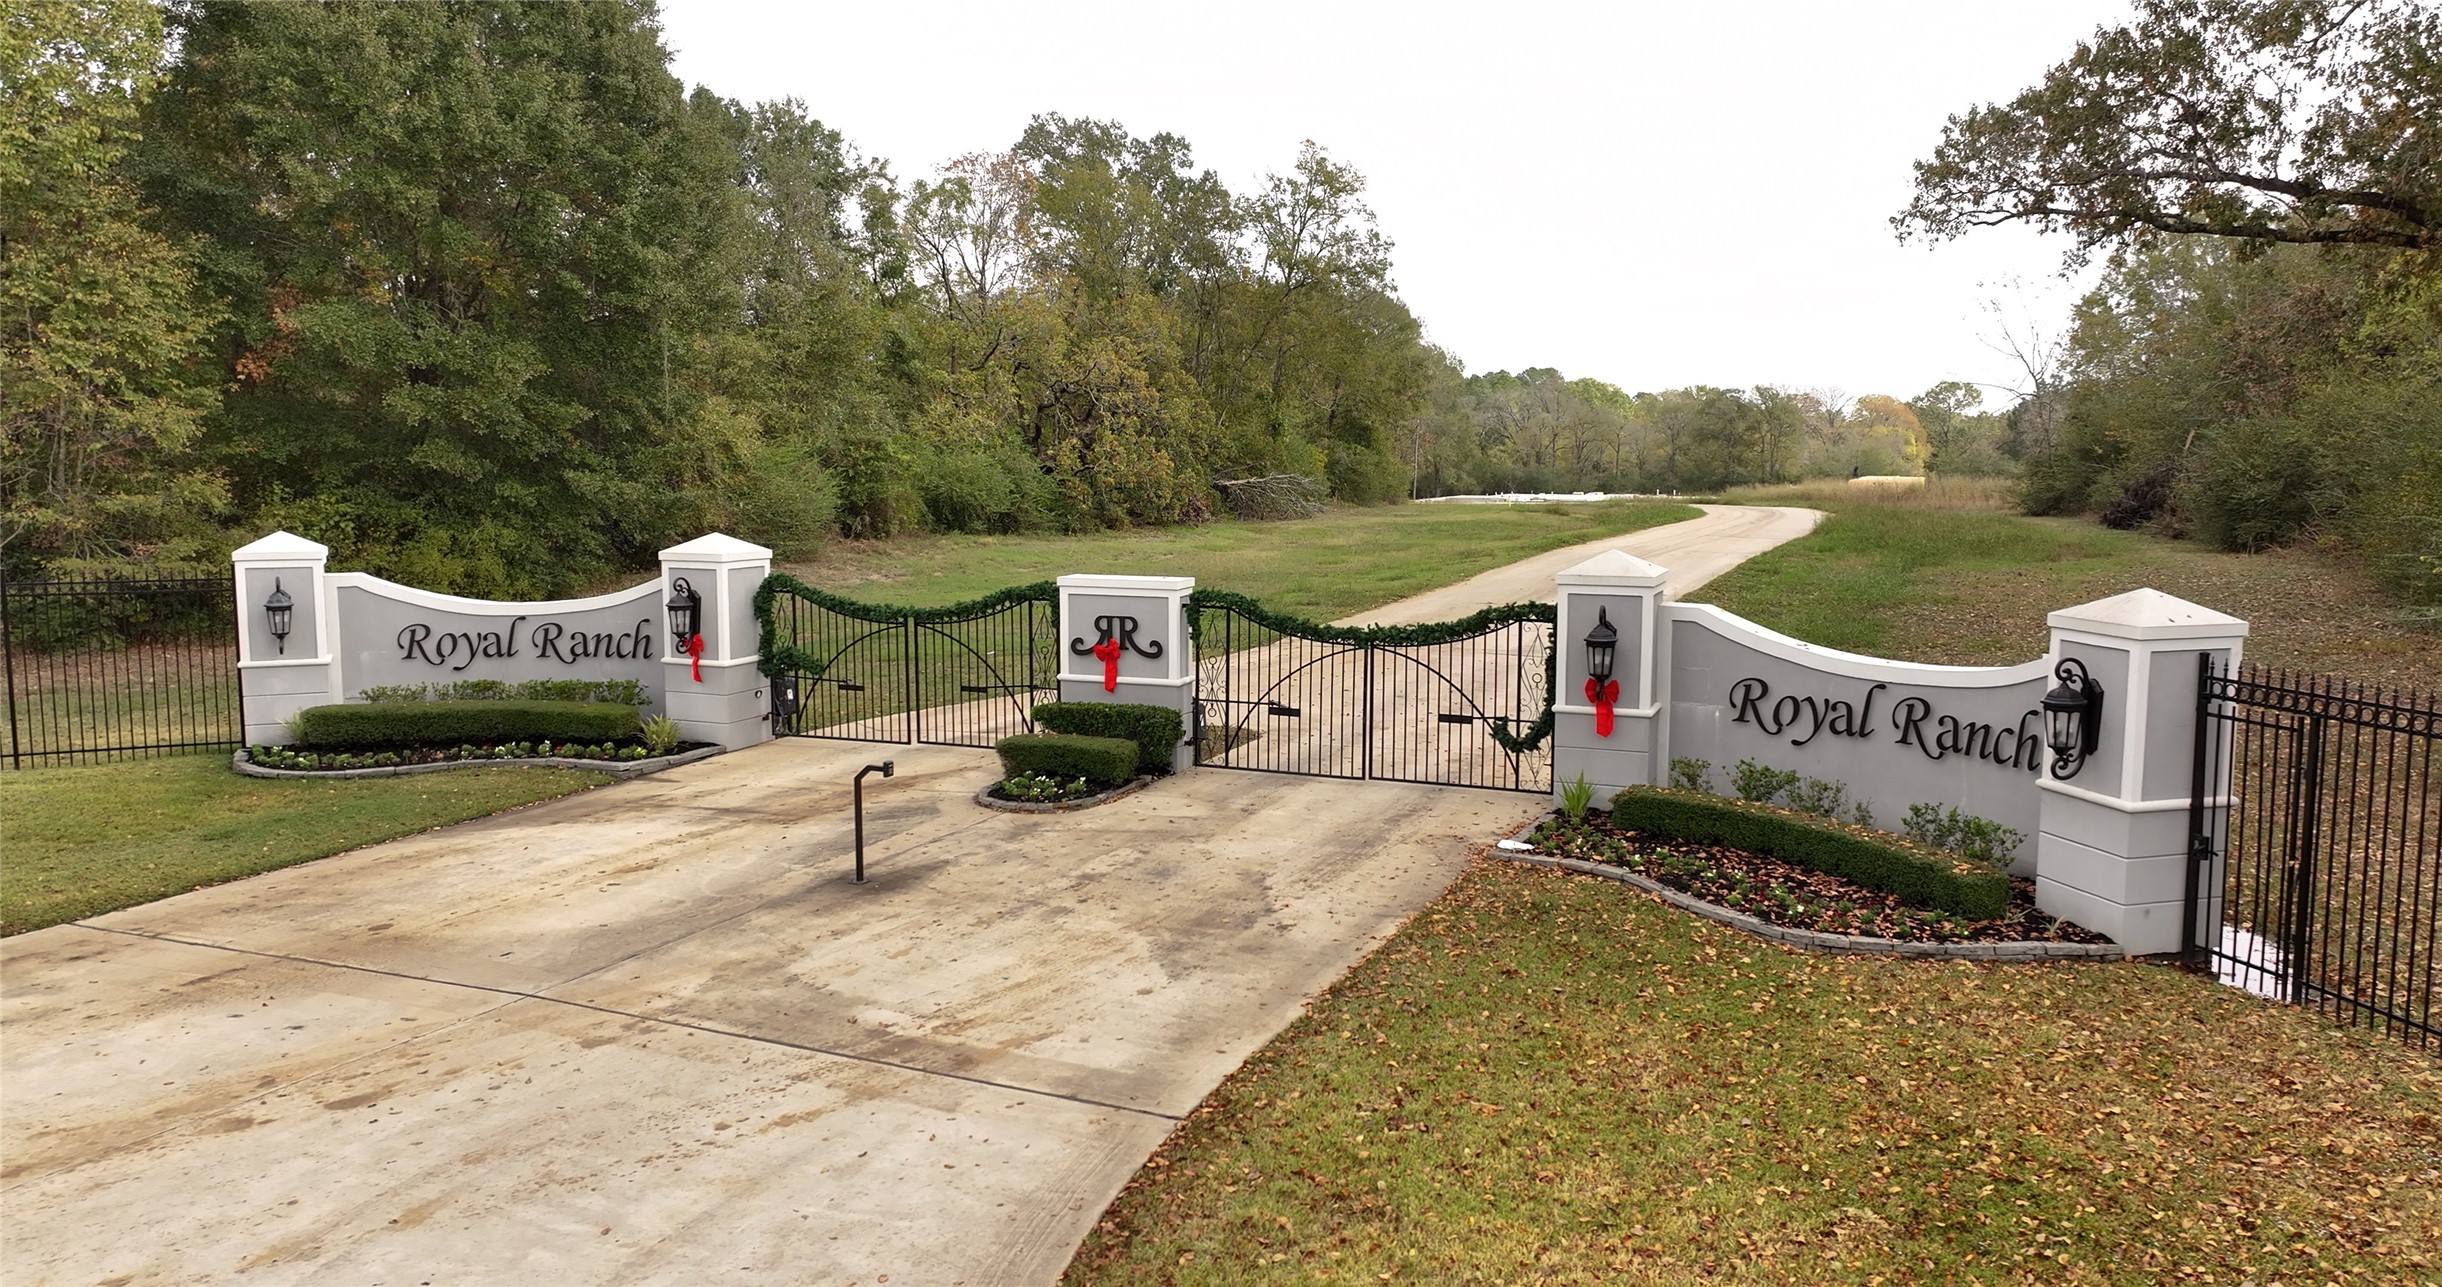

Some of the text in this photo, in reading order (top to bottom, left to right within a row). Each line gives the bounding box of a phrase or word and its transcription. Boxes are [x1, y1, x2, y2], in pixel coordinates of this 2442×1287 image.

[397, 616, 653, 671] Royal Ranch
[1729, 677, 2042, 771] Royal Ranch
